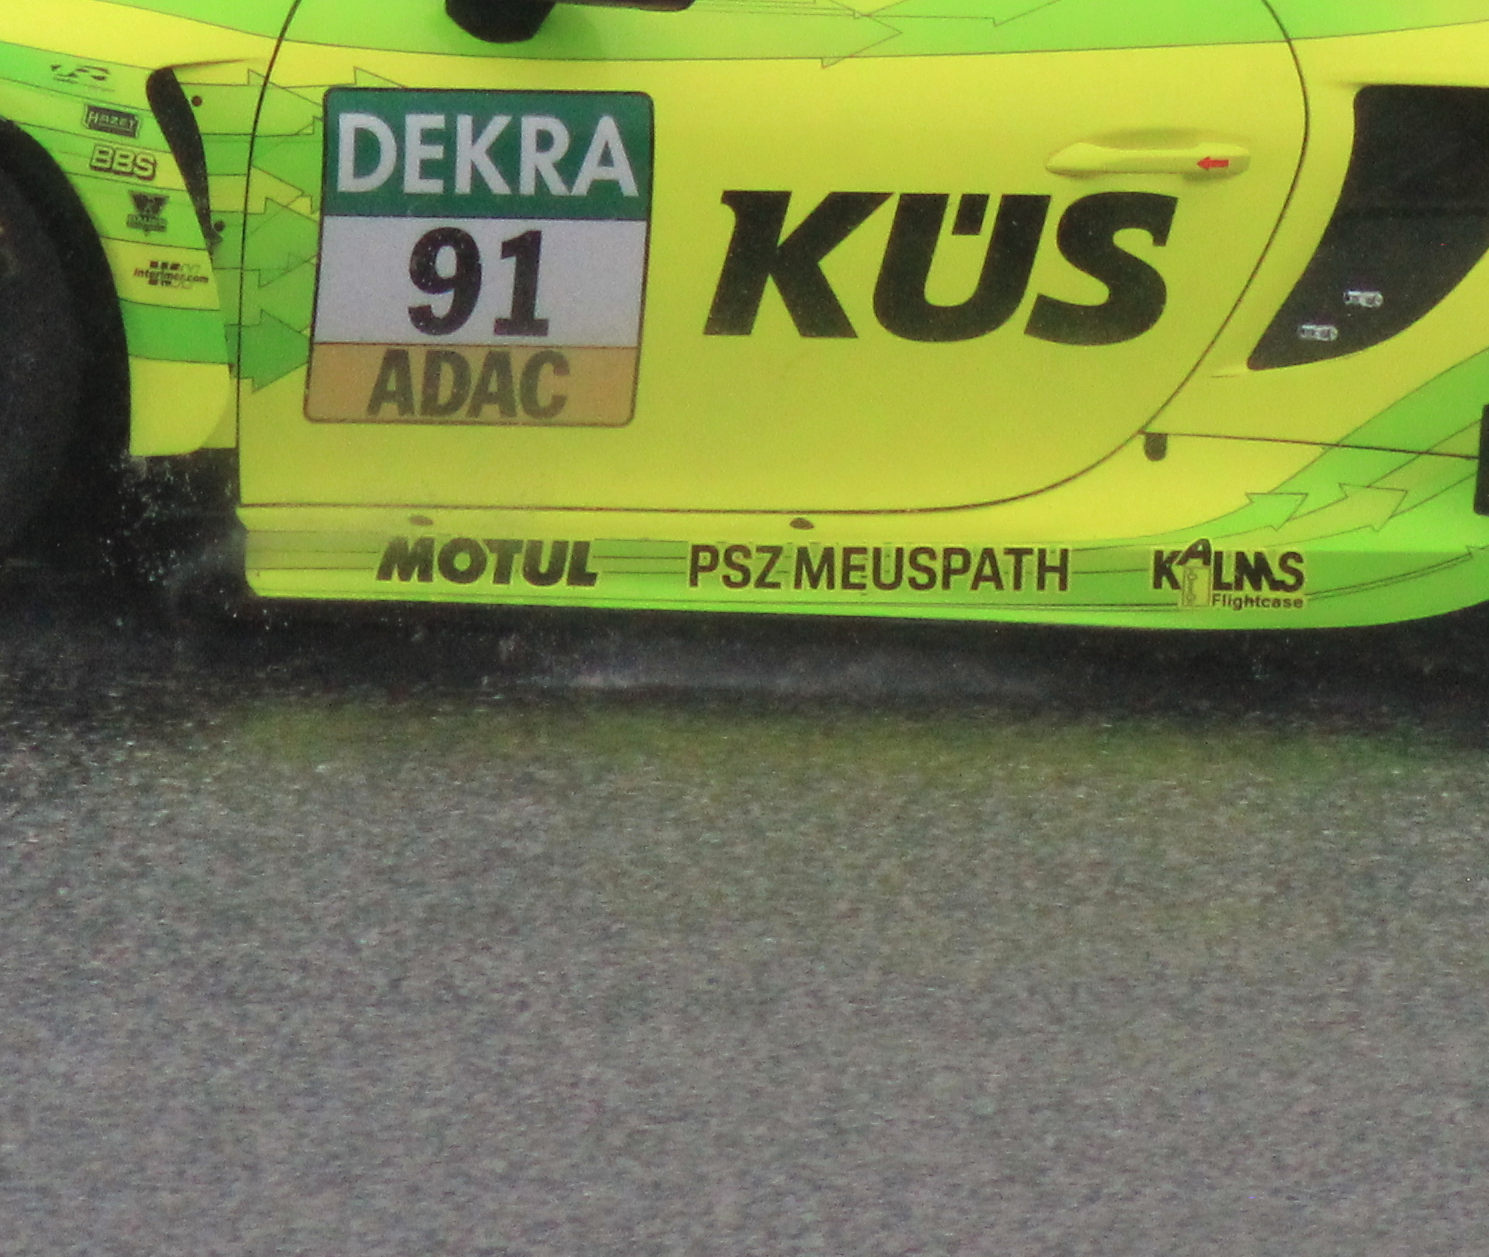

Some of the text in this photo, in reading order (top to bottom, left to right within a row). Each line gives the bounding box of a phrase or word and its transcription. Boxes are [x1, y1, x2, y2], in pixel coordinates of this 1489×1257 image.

[86, 108, 138, 132] HAZET
[89, 144, 158, 182] BBS
[335, 111, 640, 198] DEKRA
[407, 226, 550, 337] 91
[702, 190, 1179, 346] KÜS
[367, 348, 571, 420] ADAC
[376, 537, 600, 588] MOTUL
[688, 543, 1069, 592] PSZ MEUSPATH
[1151, 539, 1305, 593] KALMS
[1211, 593, 1305, 611] Flightcase
